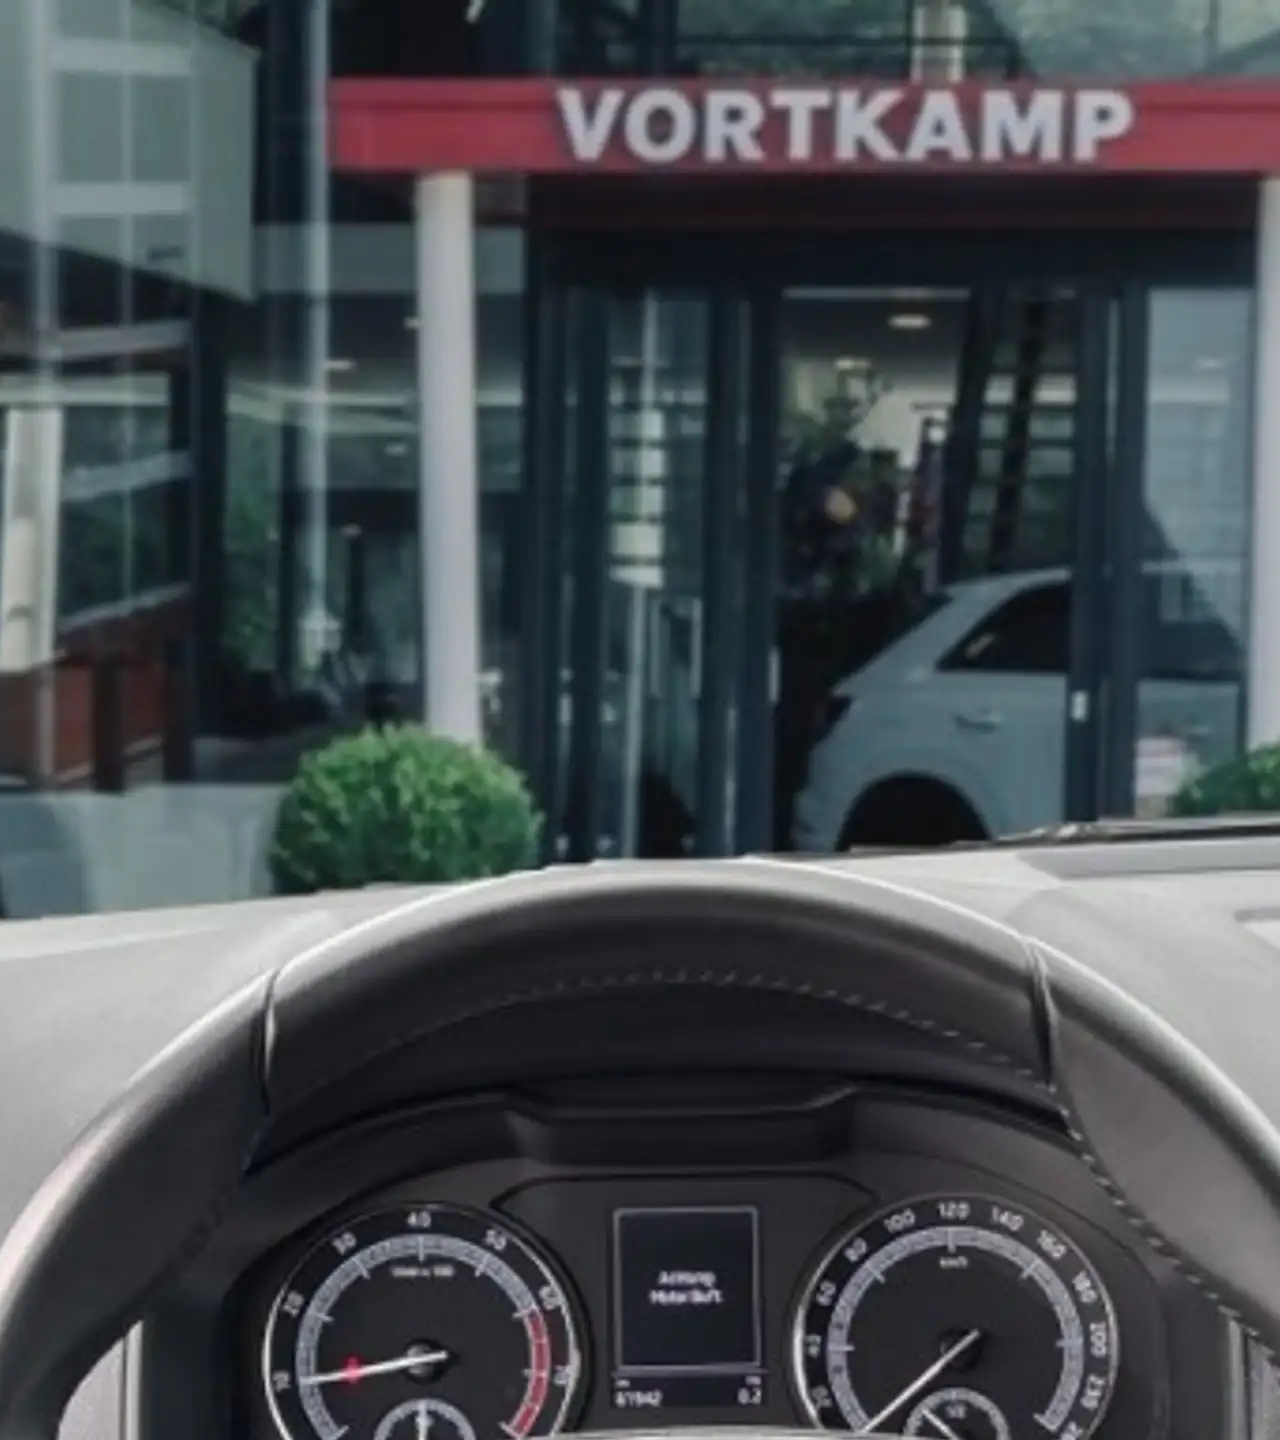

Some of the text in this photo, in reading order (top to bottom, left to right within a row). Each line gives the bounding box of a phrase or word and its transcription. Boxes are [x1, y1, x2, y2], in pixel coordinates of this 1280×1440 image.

[557, 88, 1135, 162] VORTKAMP
[406, 1211, 432, 1227] 40
[884, 1208, 915, 1233] 100
[938, 1201, 970, 1219] 120
[991, 1206, 1024, 1231] 140
